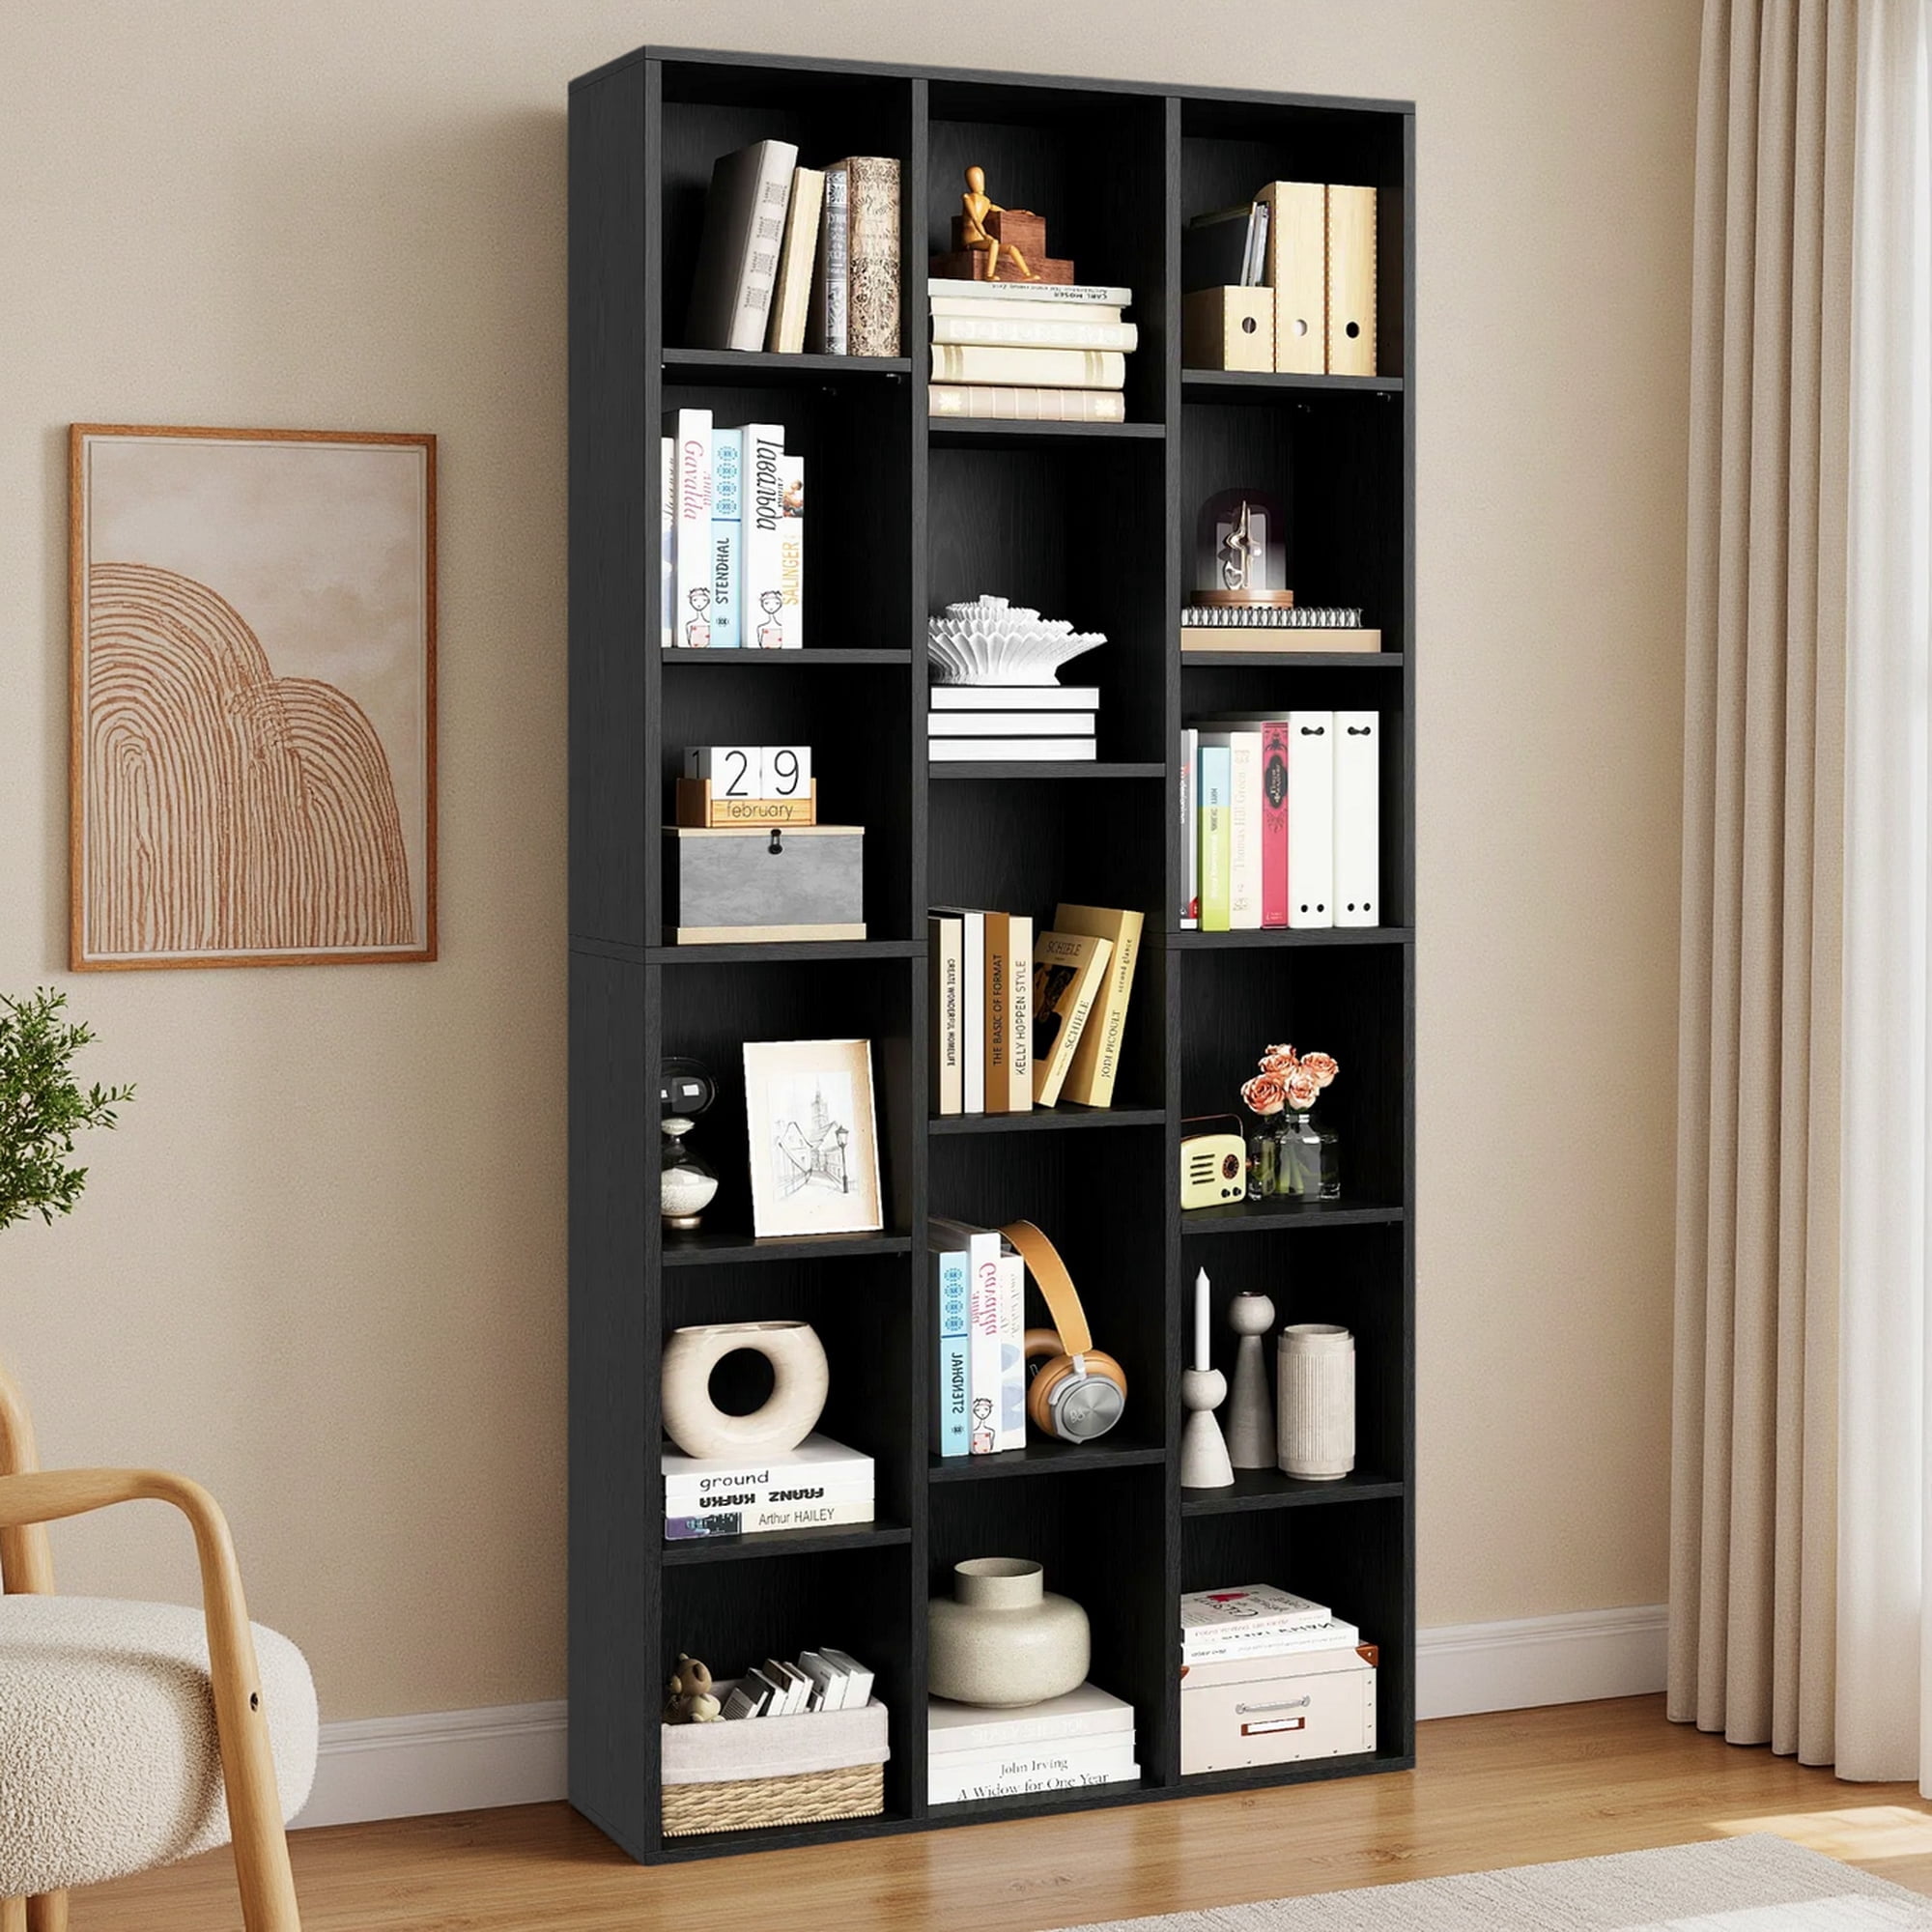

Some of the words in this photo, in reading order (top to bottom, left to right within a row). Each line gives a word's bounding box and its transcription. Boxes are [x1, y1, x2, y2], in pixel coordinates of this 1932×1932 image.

[684, 440, 705, 520] Gavalda
[716, 537, 729, 604] STENDHAL
[781, 542, 800, 606] SALINGER
[726, 800, 794, 821] february
[946, 958, 955, 985] CREATE
[993, 954, 1003, 998] FORMAT
[1015, 960, 1027, 992] STYLE
[946, 986, 955, 1030] WONDERFUL
[993, 999, 1003, 1012] OF
[1015, 994, 1027, 1040] HOPPEN
[993, 1014, 1003, 1044] BASIC
[1065, 1001, 1090, 1050] SCHIELE
[1106, 1010, 1122, 1055] PICOULT
[993, 1046, 1003, 1066] THE
[1015, 1041, 1027, 1075] KELLY
[1101, 1055, 1116, 1078] JODI
[699, 1469, 770, 1492] ground
[768, 1487, 824, 1502] FRANZ
[699, 1492, 755, 1508] KAFKA
[758, 1512, 791, 1525] Arthur
[794, 1508, 836, 1523] HAILEY
[999, 1761, 1028, 1779] John
[1032, 1758, 1068, 1772] Irving
[957, 1789, 968, 1802] A
[973, 1783, 1021, 1798] Widow
[1024, 1779, 1042, 1793] for
[1046, 1777, 1076, 1791] One
[1079, 1773, 1110, 1786] Year
